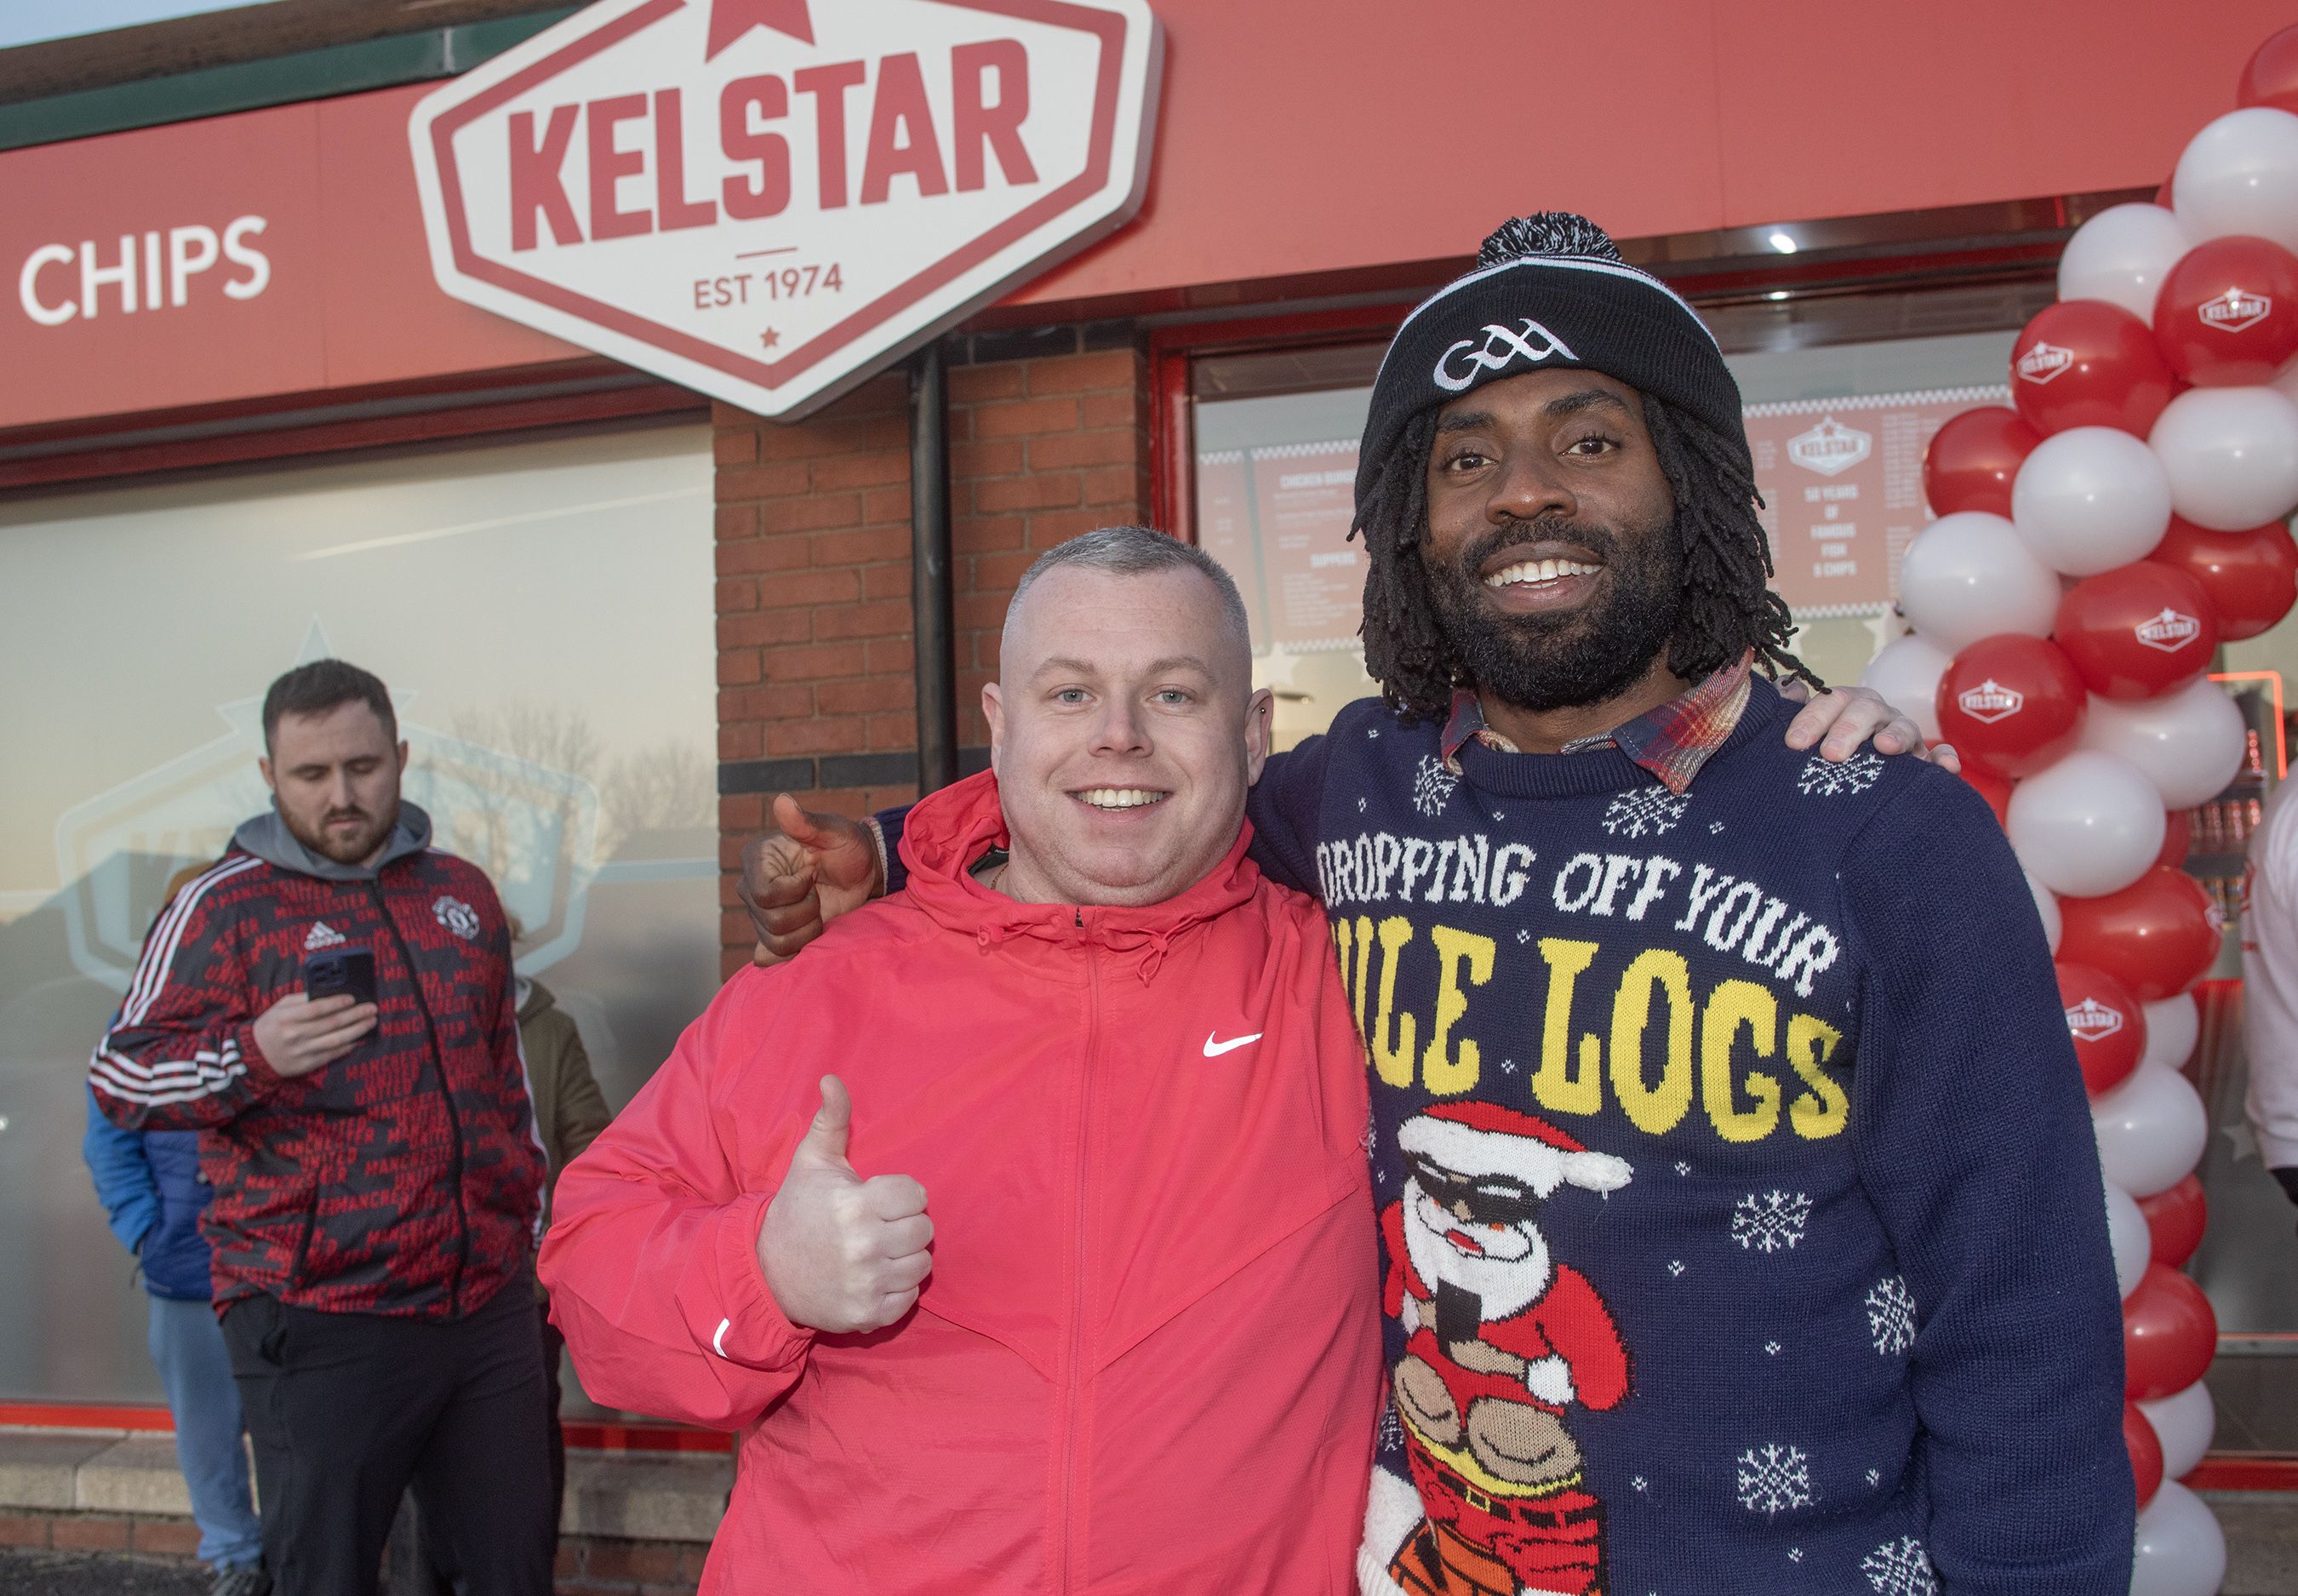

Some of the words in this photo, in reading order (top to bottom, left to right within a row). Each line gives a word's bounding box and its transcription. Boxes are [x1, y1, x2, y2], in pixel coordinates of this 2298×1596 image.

[508, 37, 1040, 252] KELSTAR
[19, 215, 271, 325] CHIPS
[694, 277, 752, 311] EST
[765, 263, 843, 300] 1974
[2206, 301, 2262, 321] KELSTAR
[2021, 352, 2065, 374] KELSTAR
[2140, 621, 2193, 640] KELSTAR
[1964, 695, 2014, 710] KELSTAR
[1317, 831, 1537, 909] DROPPING
[1553, 852, 1683, 920] OFF
[1674, 862, 1841, 998] YOUR
[1330, 915, 1496, 1095] ULE
[1532, 936, 1849, 1143] LOGS
